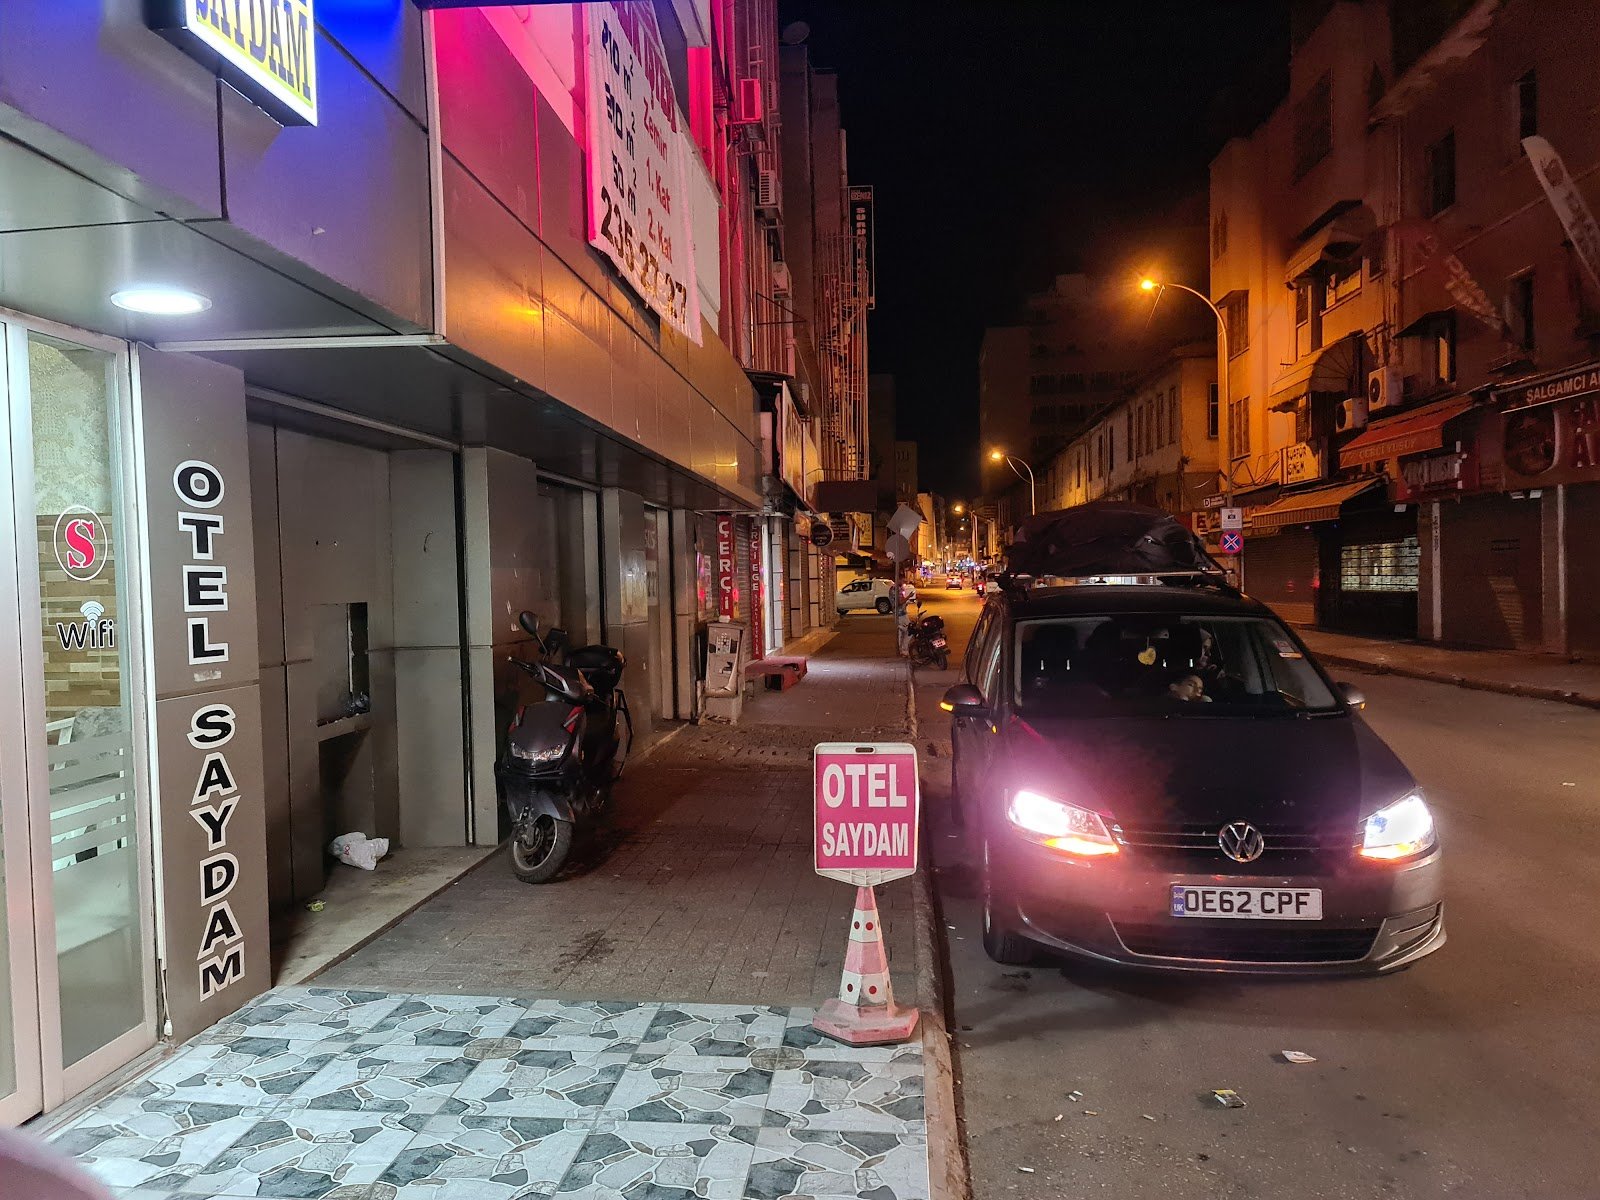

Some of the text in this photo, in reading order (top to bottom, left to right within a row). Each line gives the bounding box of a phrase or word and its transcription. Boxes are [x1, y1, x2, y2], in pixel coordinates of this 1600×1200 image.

[196, 0, 311, 101] YDAM
[643, 96, 667, 164] Zemin
[655, 170, 671, 214] Kat
[173, 460, 229, 665] OTEL
[56, 619, 114, 650] Wifi
[822, 763, 907, 808] OTEL
[187, 704, 245, 1002] SAYDAM
[822, 822, 909, 857] SAYDAM
[1173, 890, 1311, 915] UK OE62 CPF
